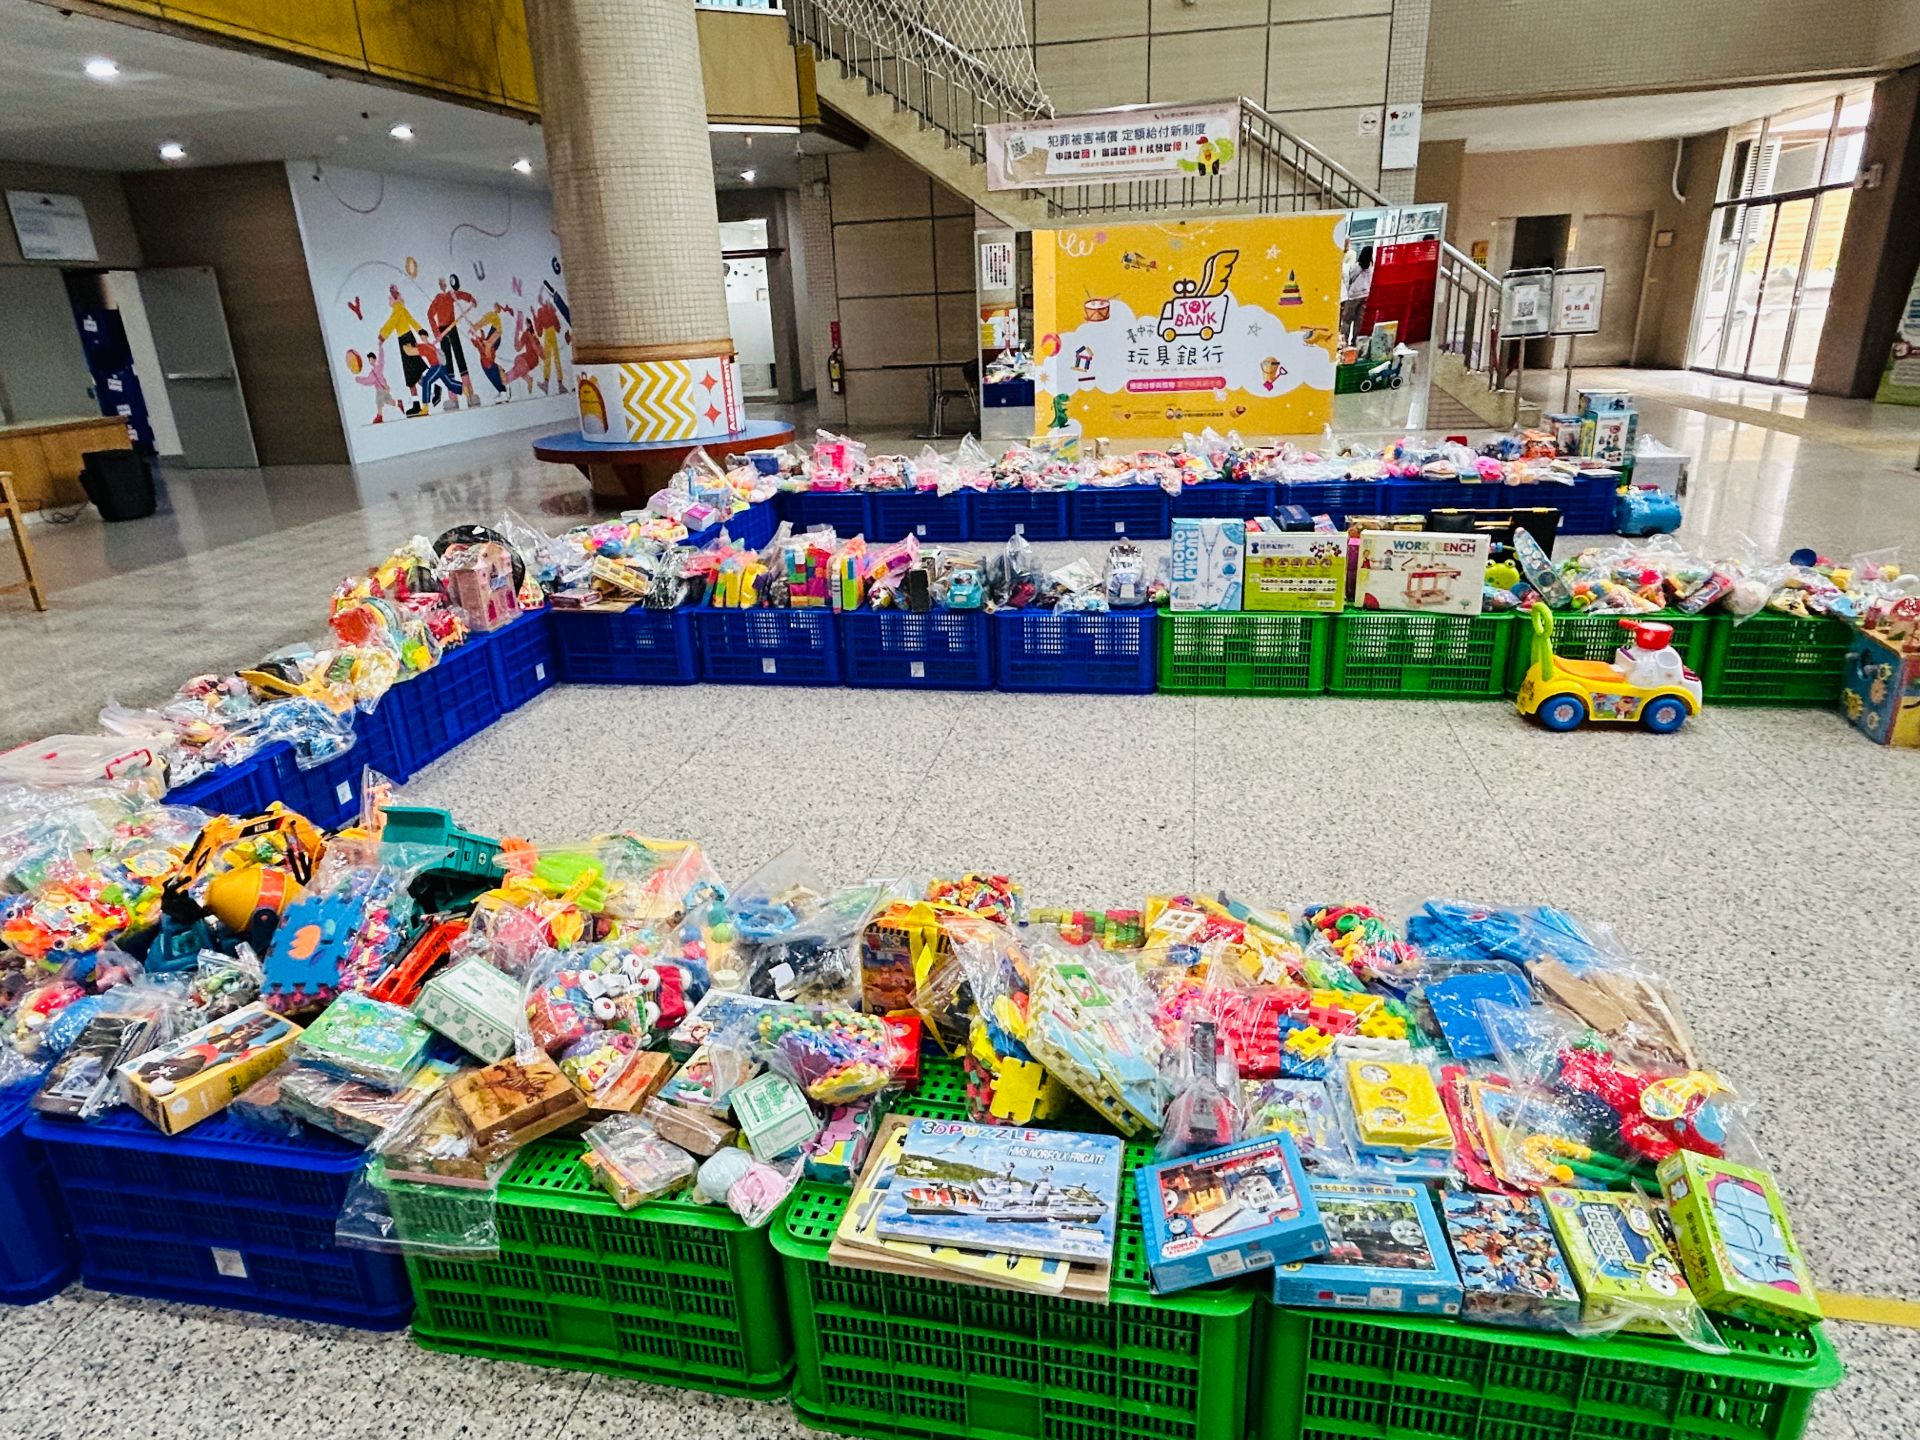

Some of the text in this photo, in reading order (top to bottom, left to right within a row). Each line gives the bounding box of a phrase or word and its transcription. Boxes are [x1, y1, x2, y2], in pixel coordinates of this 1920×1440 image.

[1047, 123, 1207, 148] 犯罪被害補償 定額給付新制度
[1180, 300, 1212, 315] TOY
[1174, 312, 1218, 327] BANK
[1127, 345, 1224, 366] 玩具銀行
[1393, 540, 1430, 551] WORK
[1007, 1145, 1106, 1165] HMS NORFOLK FRIGATE
